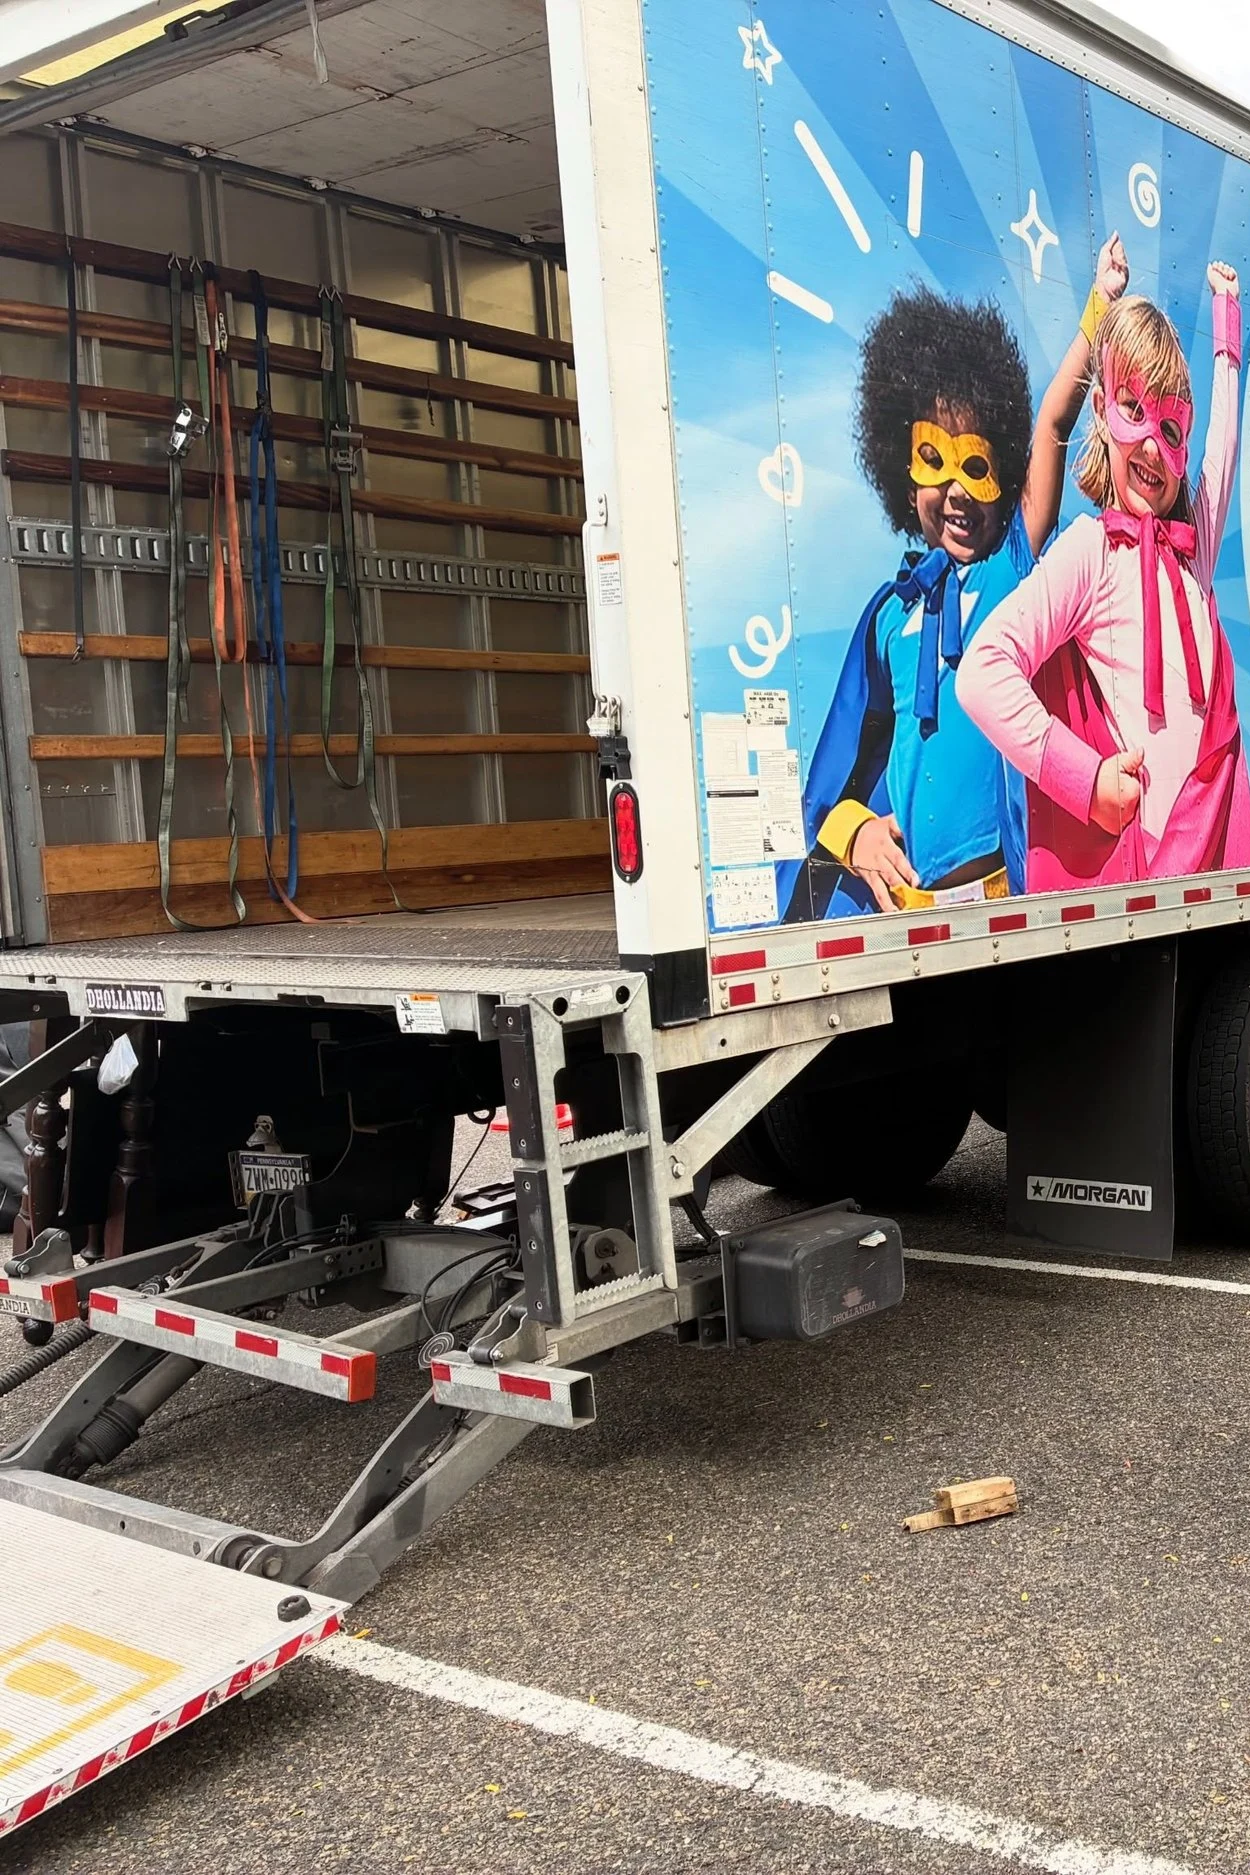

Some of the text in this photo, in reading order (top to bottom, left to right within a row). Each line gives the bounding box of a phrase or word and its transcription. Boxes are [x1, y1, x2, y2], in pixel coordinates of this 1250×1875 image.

[86, 988, 165, 1012] DHOLLANDIA
[1051, 1182, 1146, 1207] MORGAN
[831, 1300, 878, 1325] DHOLLANDIA
